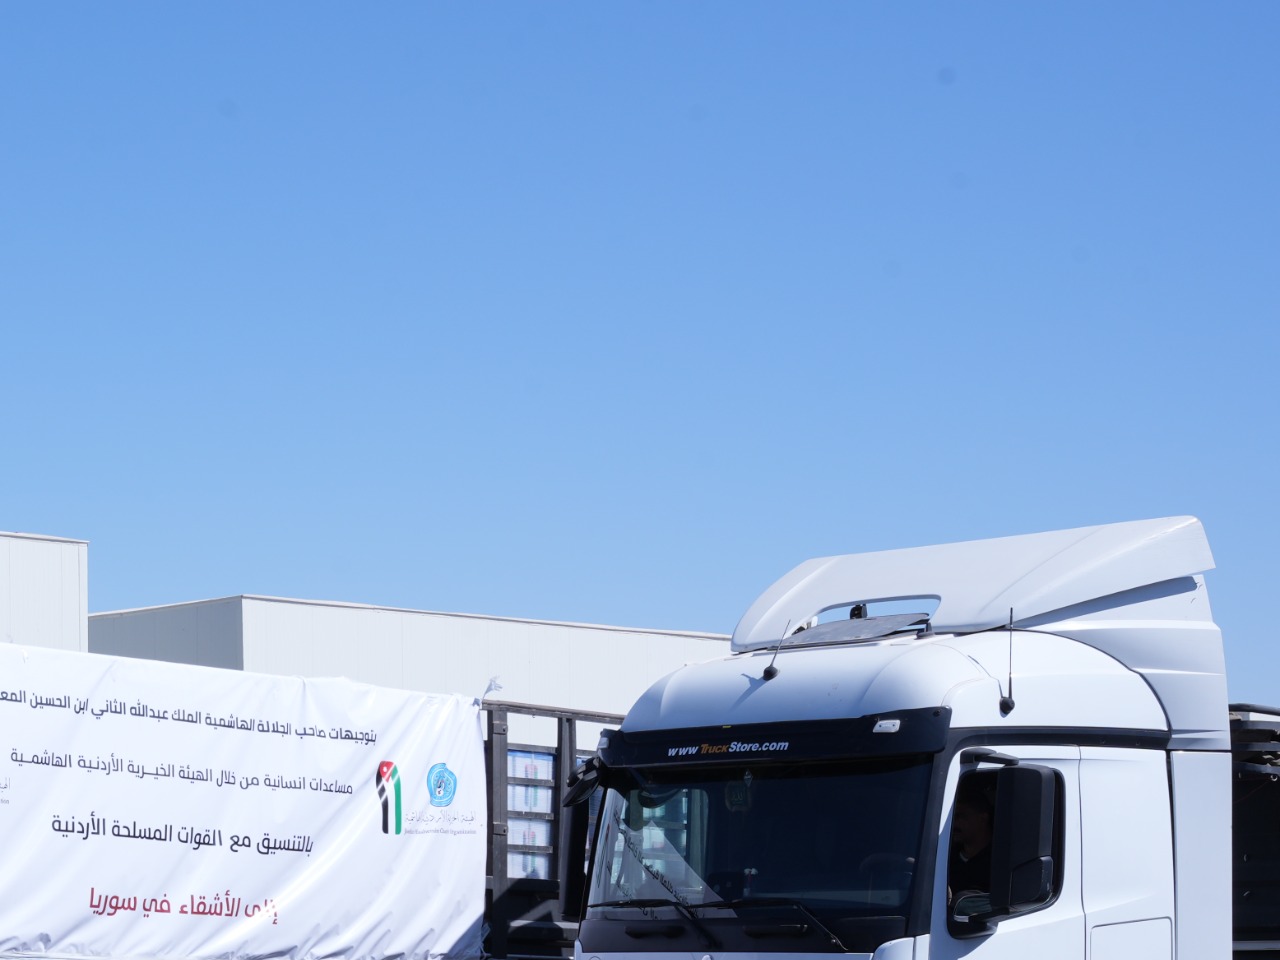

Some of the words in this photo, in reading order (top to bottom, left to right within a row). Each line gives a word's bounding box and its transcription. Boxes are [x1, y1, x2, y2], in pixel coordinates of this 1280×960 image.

[30, 692, 70, 709] الحسين
[74, 698, 89, 715] ابن
[91, 699, 126, 720] الثاني
[130, 699, 168, 722] عبدالله
[171, 709, 201, 724] الملك
[205, 714, 255, 731] الهاشمية
[257, 720, 291, 737] الجلالة
[295, 725, 326, 739] صاحب
[329, 727, 377, 746] بتوجيهات
[11, 748, 72, 768] الهاشمية
[77, 753, 123, 775] الأردنية
[127, 760, 174, 780] الخيرية
[178, 765, 212, 784] الهيئة
[216, 769, 236, 787] خلال
[239, 776, 259, 790] من
[264, 773, 305, 791] انسانية
[310, 778, 353, 795] مساعدات
[51, 810, 106, 840] الأردنية
[112, 819, 173, 842] المسلحة
[177, 827, 222, 850] القوات
[230, 834, 251, 852] مع
[257, 833, 313, 857] بالتنسيق
[88, 887, 137, 916] سوريا
[143, 893, 171, 918] في
[179, 890, 240, 917] الأشقاء
